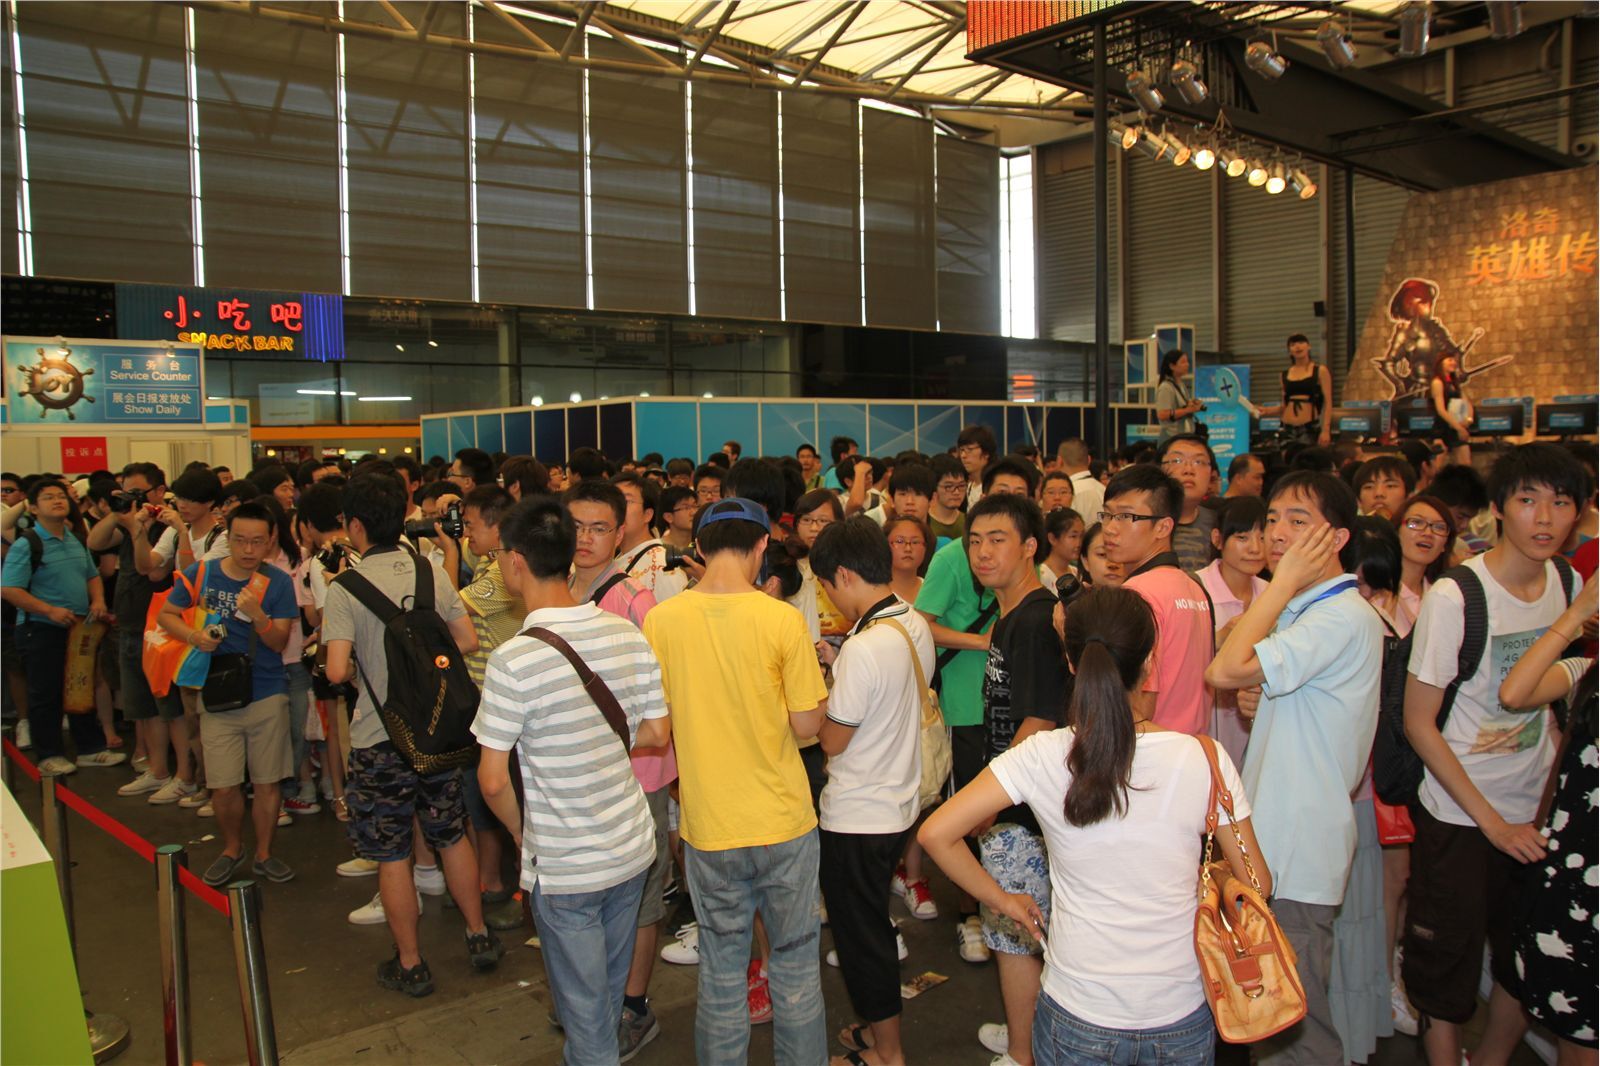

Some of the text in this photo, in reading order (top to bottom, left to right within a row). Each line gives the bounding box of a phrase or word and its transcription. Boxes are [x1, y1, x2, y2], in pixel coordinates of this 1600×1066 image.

[1500, 206, 1559, 239] 洛奇
[1465, 231, 1599, 285] 英雄传
[163, 295, 303, 331] 小吃吧
[253, 335, 295, 351] BAR
[110, 370, 192, 381] Service Counter
[121, 358, 181, 371] 服务台
[124, 404, 182, 416] Show Daily
[427, 679, 447, 736] adidas
